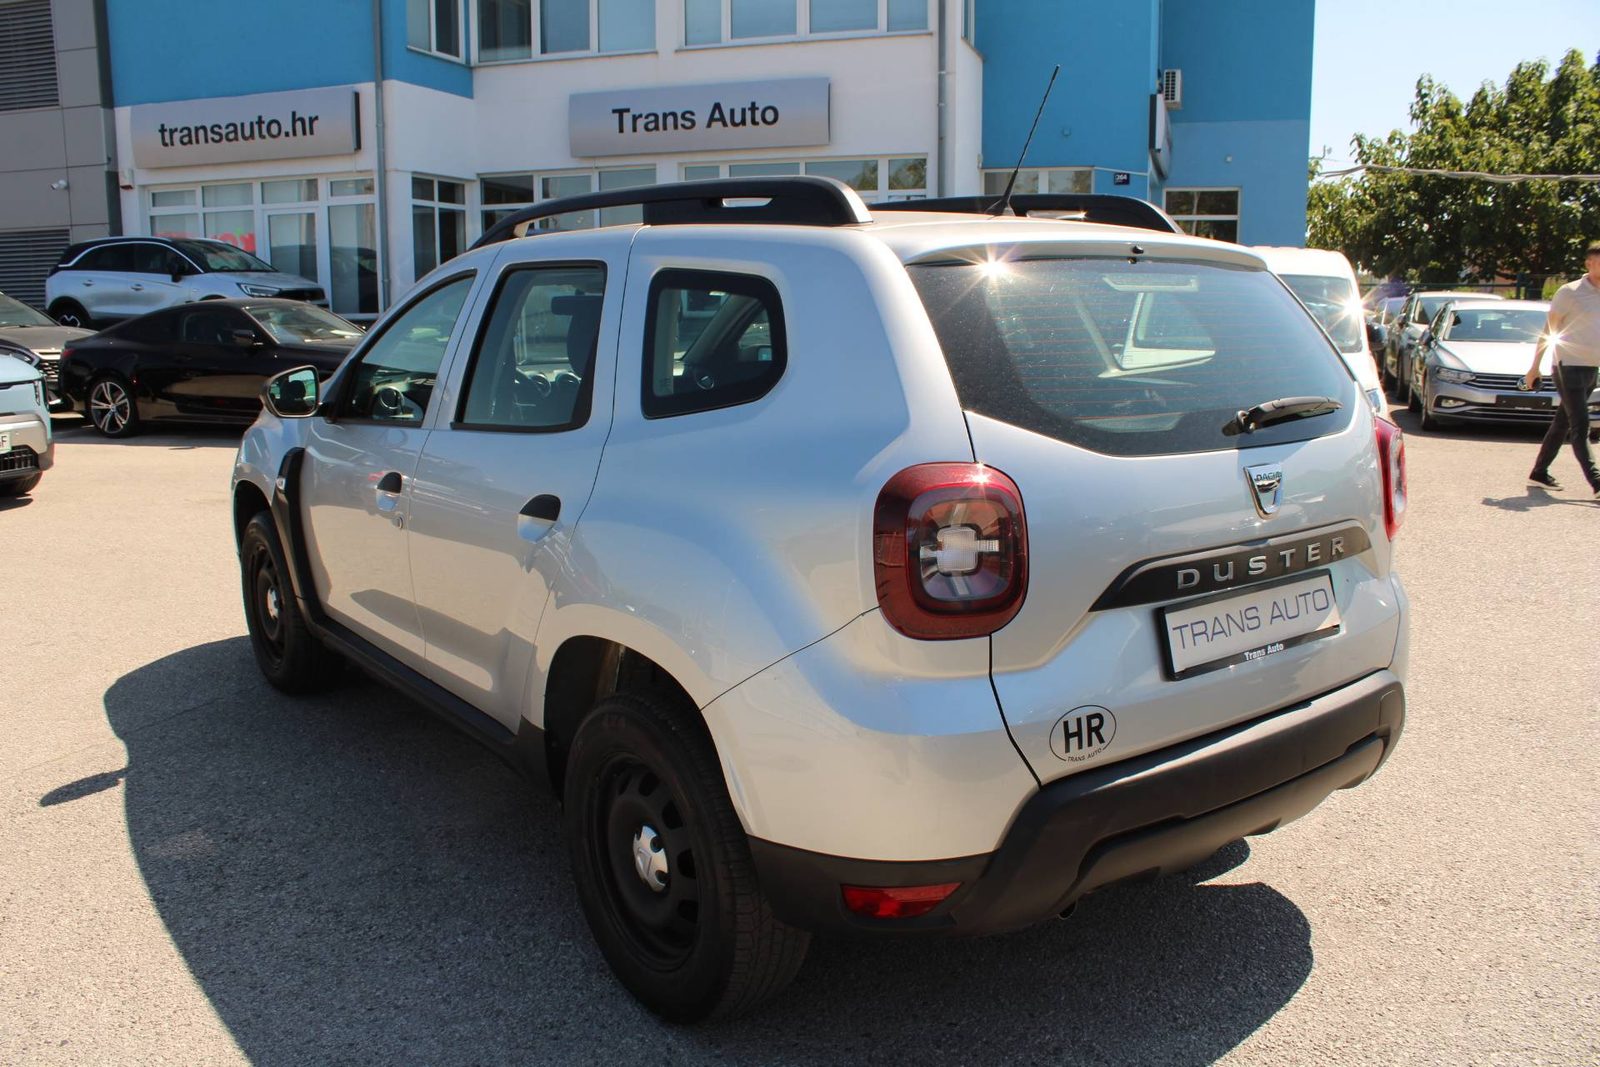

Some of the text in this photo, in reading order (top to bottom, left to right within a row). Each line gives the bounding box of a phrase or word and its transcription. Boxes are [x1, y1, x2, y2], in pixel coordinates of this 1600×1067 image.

[158, 110, 320, 148] transauto.hr
[612, 101, 780, 134] Trans Auto
[1177, 536, 1345, 590] DUSTER
[1172, 588, 1330, 649] TRANS AUTO
[1243, 643, 1284, 661] Trans Auto
[1063, 712, 1105, 754] HR
[1067, 747, 1102, 763] TRANS AUTO
